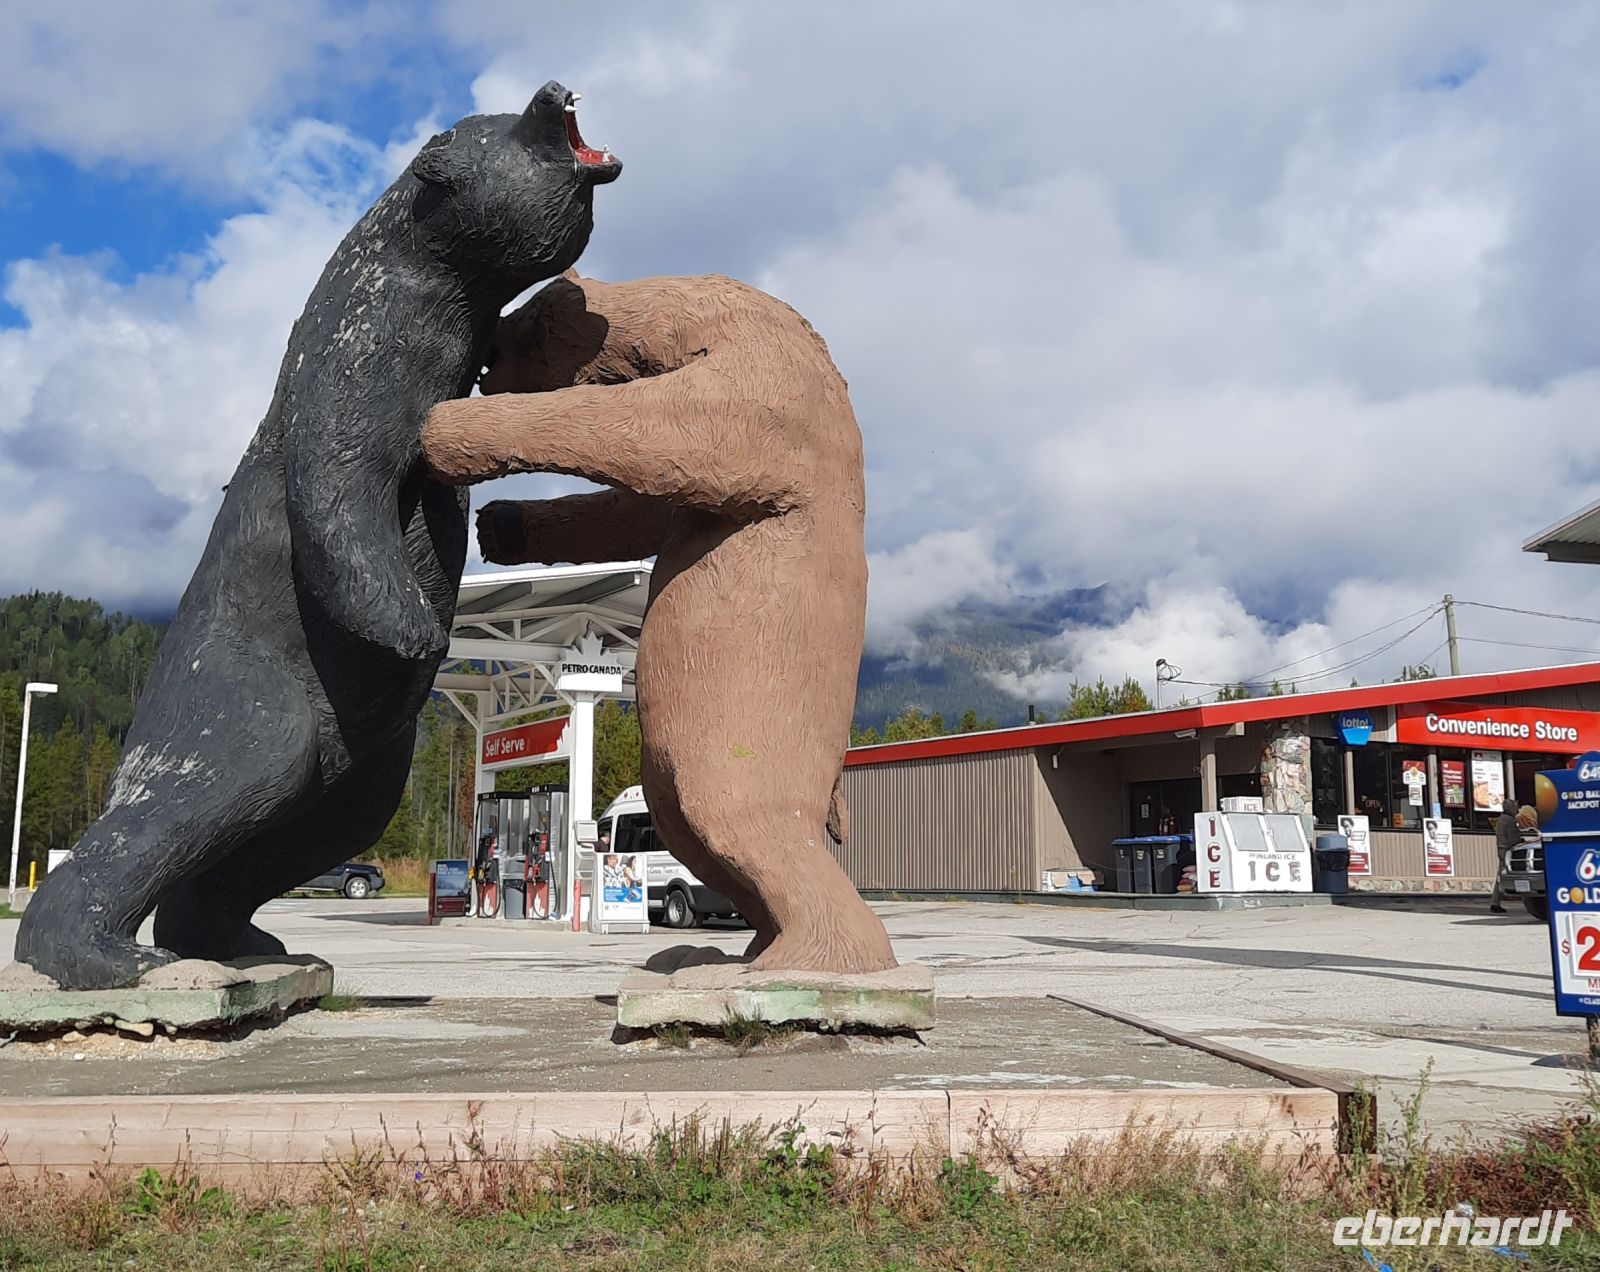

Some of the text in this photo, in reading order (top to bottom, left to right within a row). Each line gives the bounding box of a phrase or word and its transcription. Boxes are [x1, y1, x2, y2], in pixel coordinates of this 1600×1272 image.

[1425, 713, 1578, 741] Convenience Store
[485, 737, 525, 757] Self Serve
[1243, 803, 1258, 812] ICE
[1567, 800, 1600, 809] JACKPOT
[1248, 861, 1301, 882] ICE
